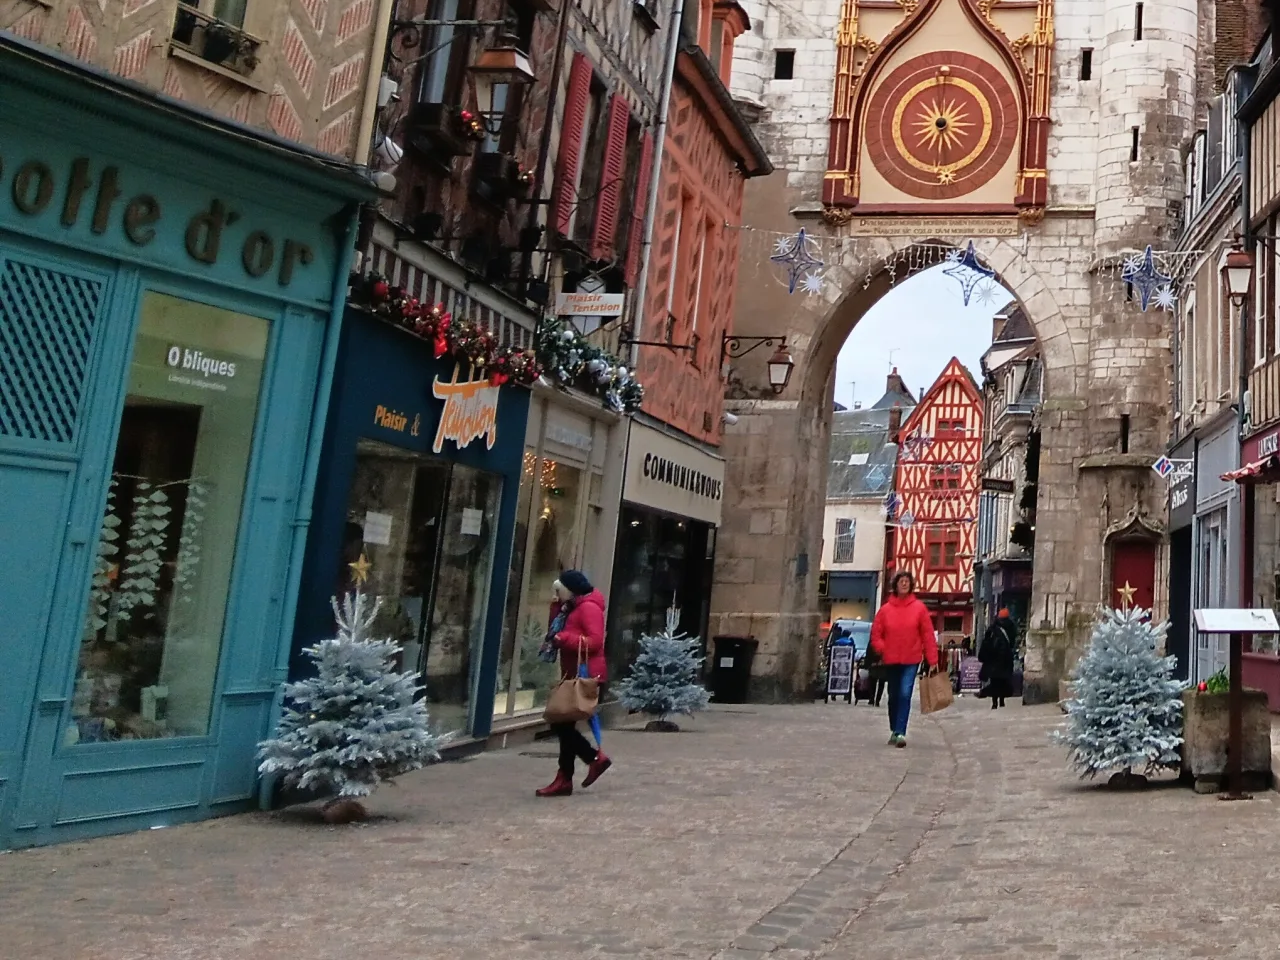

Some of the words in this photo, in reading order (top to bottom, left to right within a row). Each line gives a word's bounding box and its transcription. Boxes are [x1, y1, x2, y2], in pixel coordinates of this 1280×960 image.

[0, 157, 161, 246] otte
[185, 198, 314, 285] d'or
[567, 293, 603, 303] Plaisir
[573, 302, 621, 313] Tentation
[183, 349, 236, 377] bliques
[374, 404, 409, 433] Plaisir
